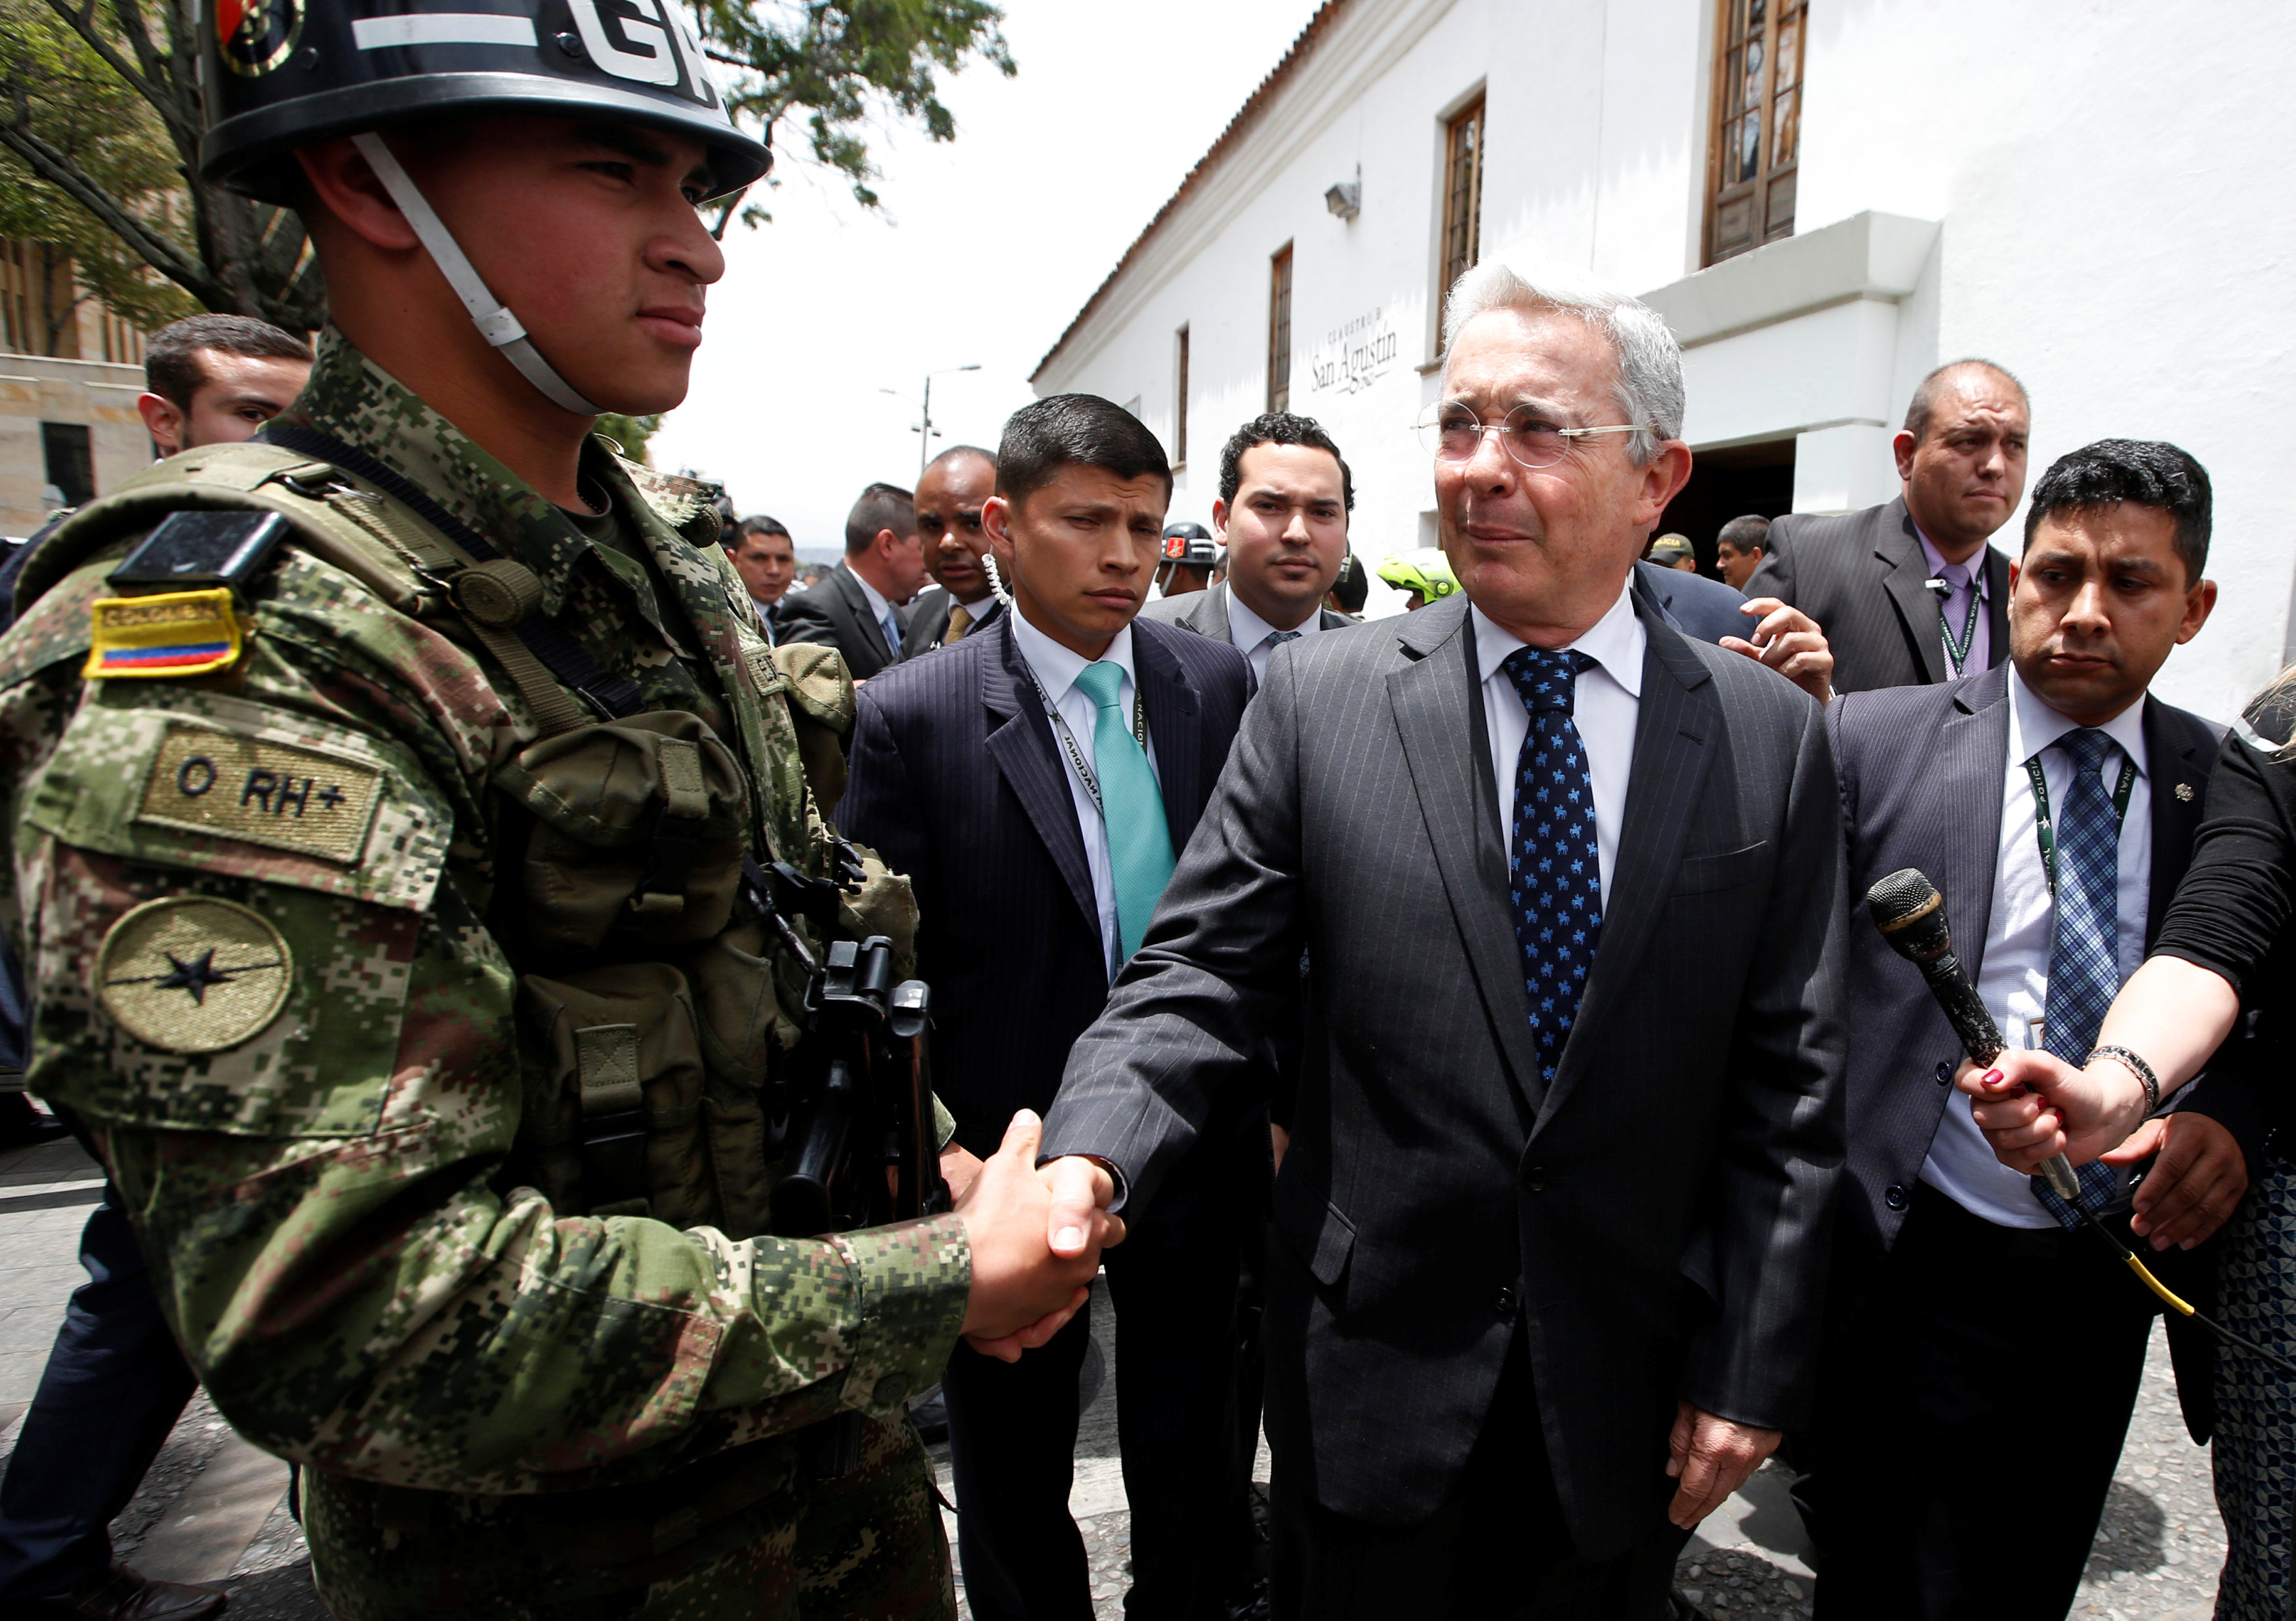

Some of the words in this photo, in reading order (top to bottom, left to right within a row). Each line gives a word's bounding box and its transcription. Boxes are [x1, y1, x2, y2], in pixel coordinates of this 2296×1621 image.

[1326, 311, 1372, 344] CLAUSTRO
[1311, 353, 1335, 392] San
[1338, 319, 1397, 395] Agustín
[178, 756, 217, 796] O
[239, 768, 346, 818] RH+
[2029, 758, 2047, 802] POLICIA
[2119, 765, 2133, 793] ONAL
